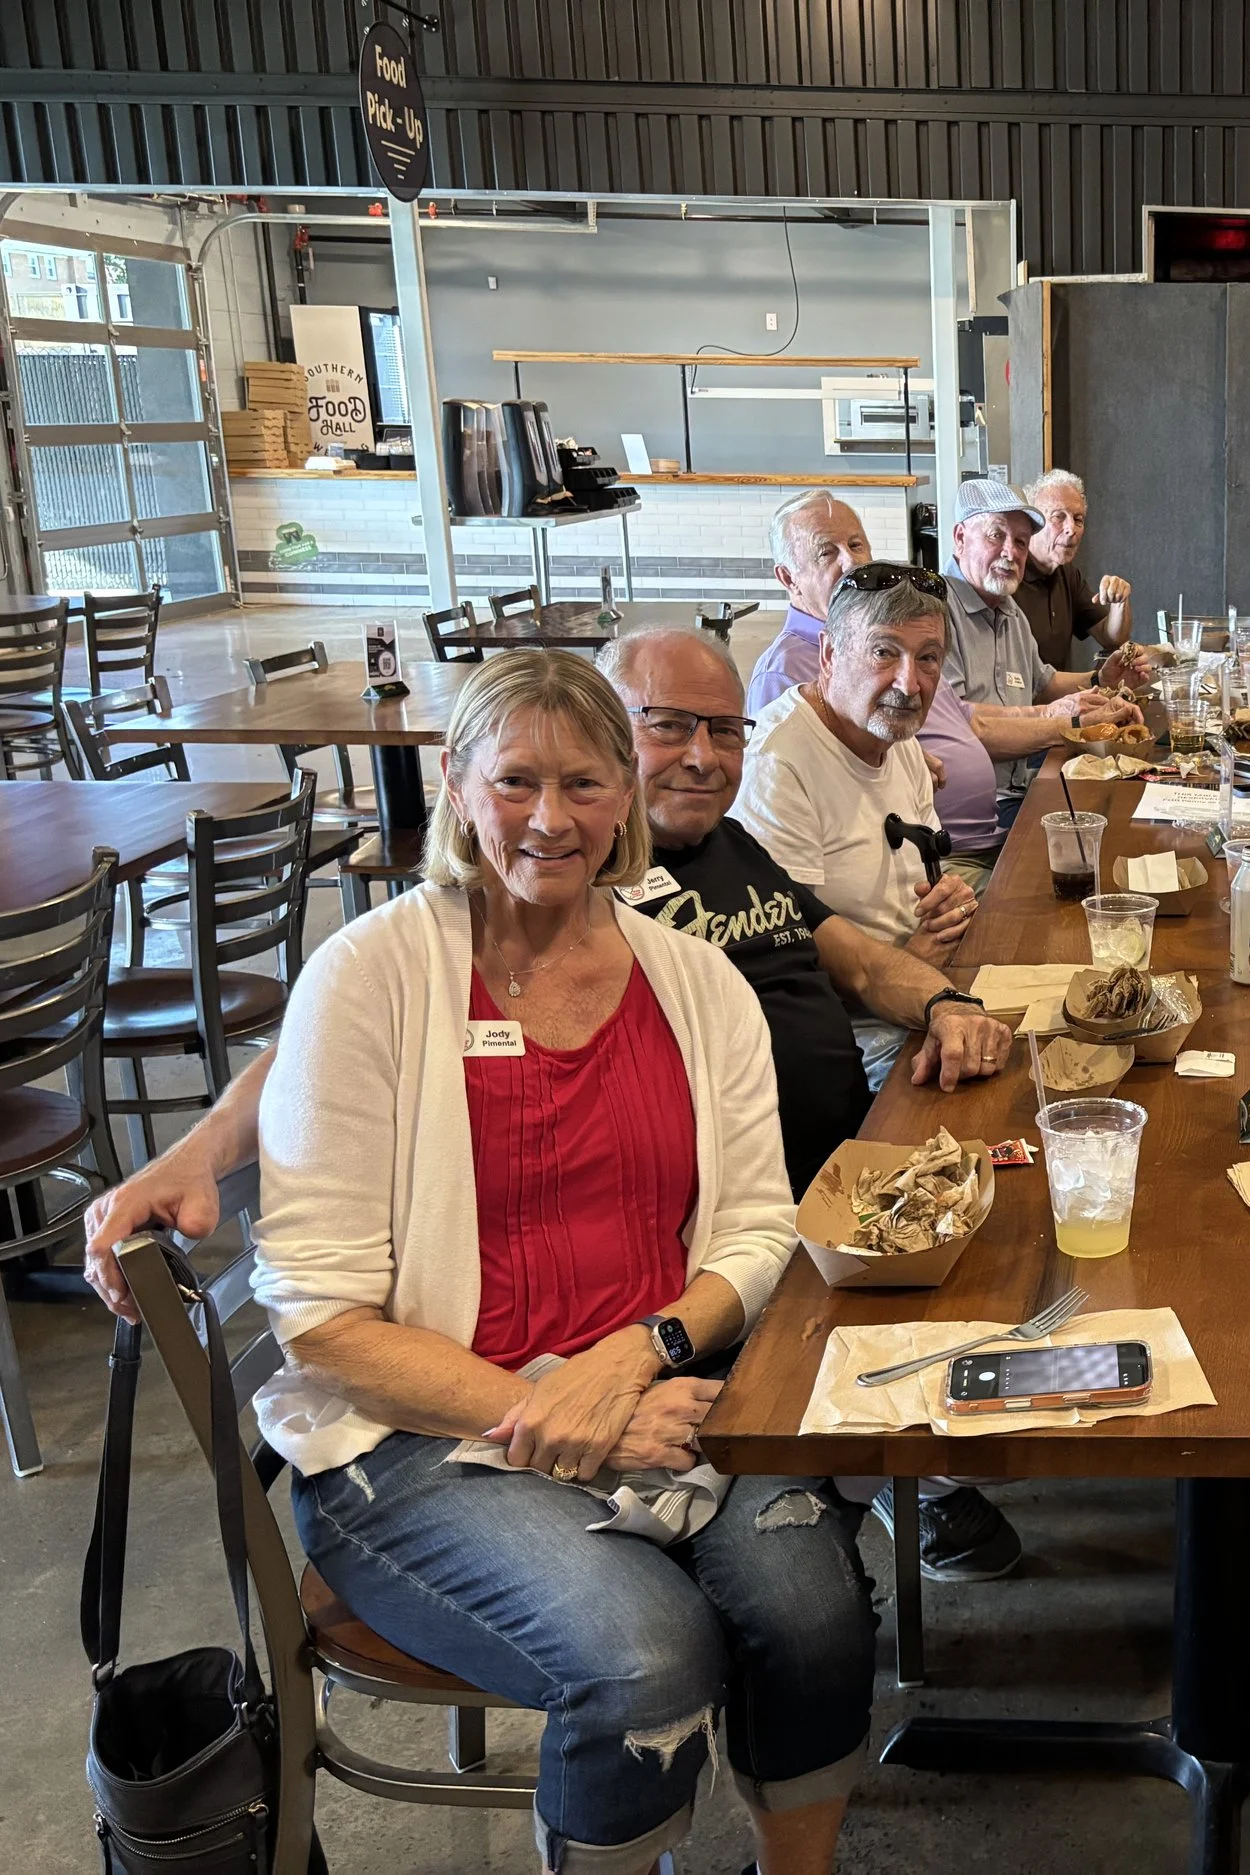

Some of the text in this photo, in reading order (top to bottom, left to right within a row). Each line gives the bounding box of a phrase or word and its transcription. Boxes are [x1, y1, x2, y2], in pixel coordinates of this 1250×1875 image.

[375, 44, 407, 89] Food
[308, 396, 367, 423] FOOD
[320, 419, 356, 437] HALL
[647, 875, 664, 885] Jerry
[654, 885, 802, 947] Fender
[773, 930, 795, 947] EST.
[485, 1030, 511, 1040] Jody
